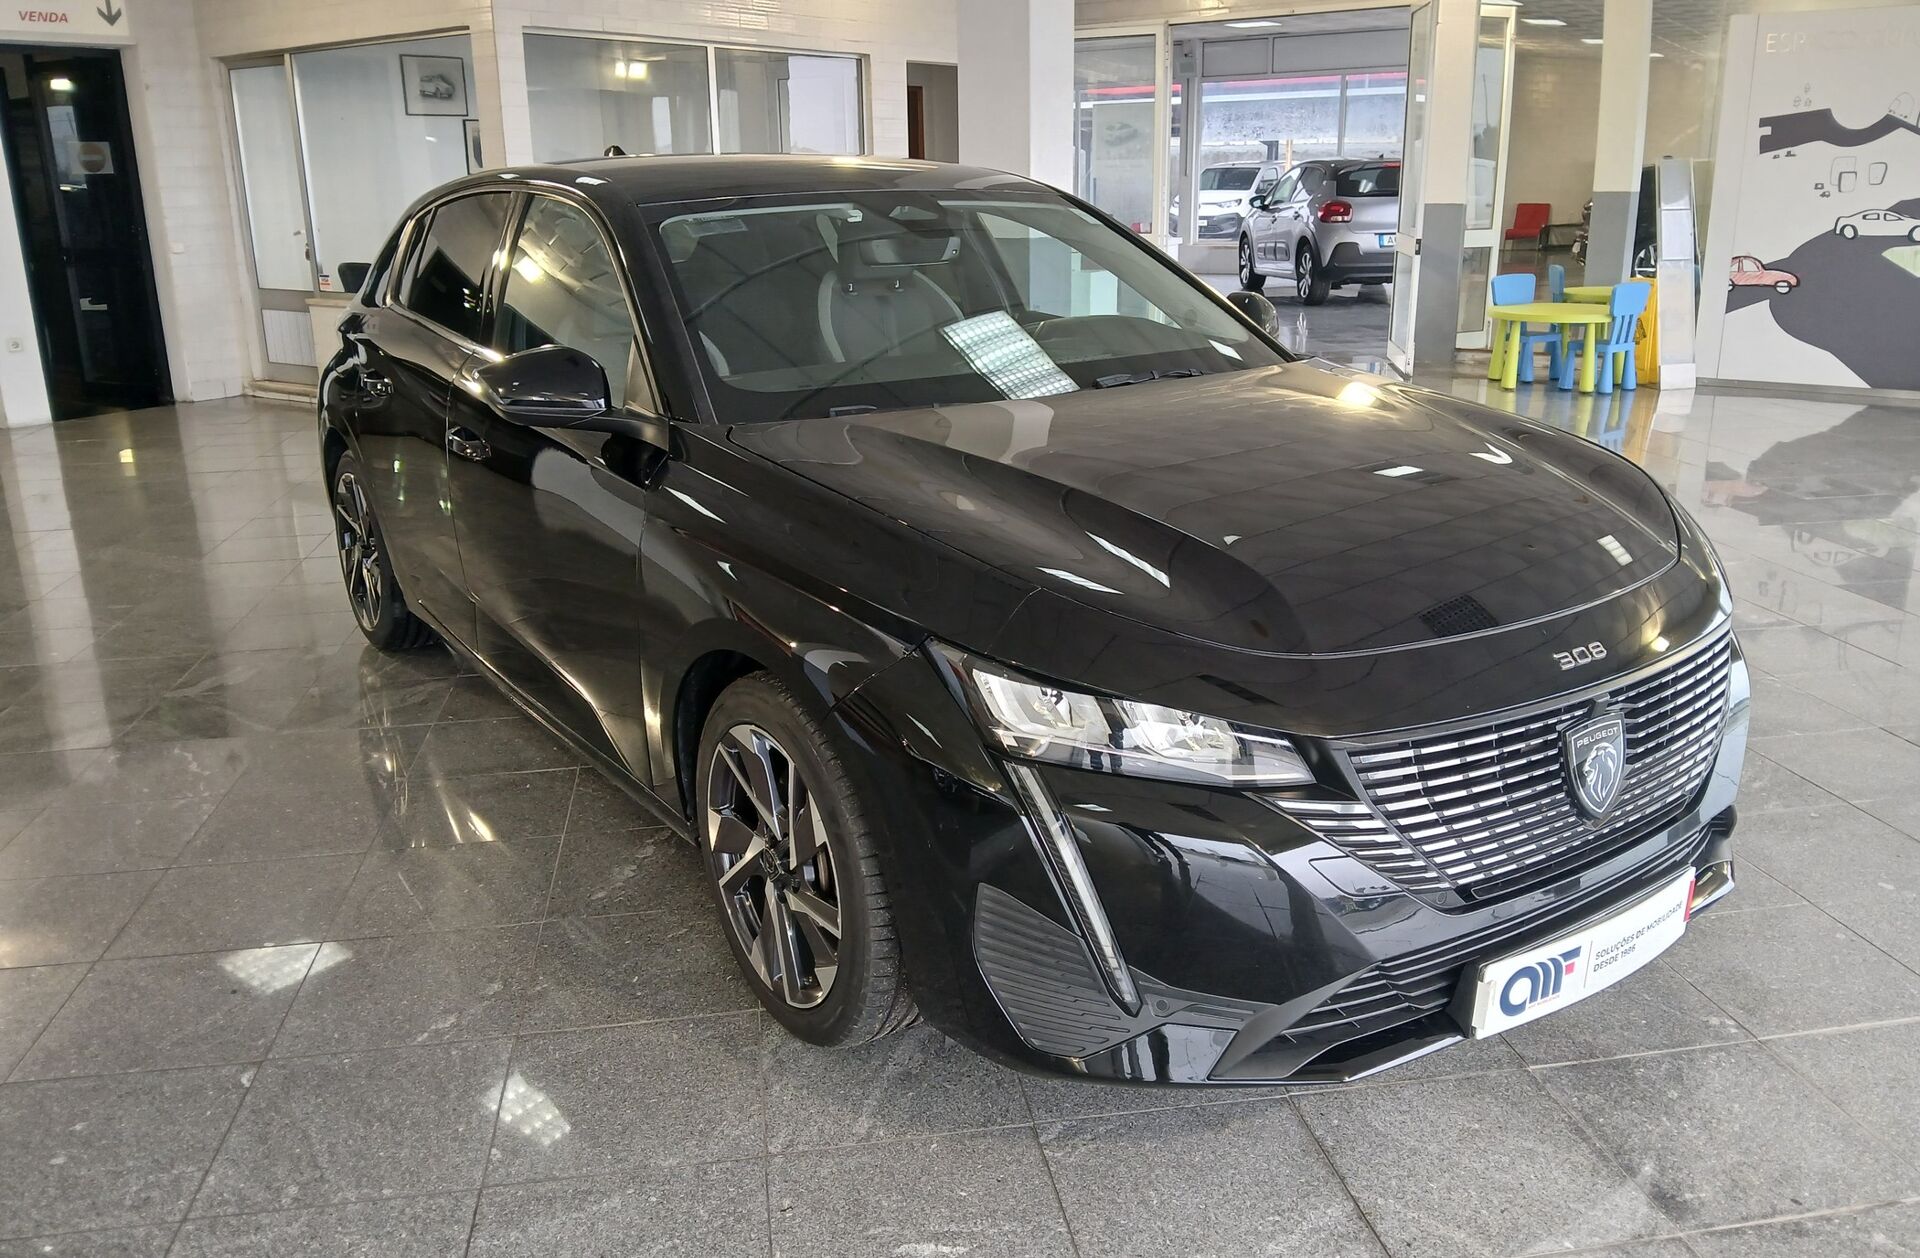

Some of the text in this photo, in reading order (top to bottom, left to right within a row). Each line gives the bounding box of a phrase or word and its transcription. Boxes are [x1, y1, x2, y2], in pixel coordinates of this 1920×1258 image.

[18, 10, 69, 23] VENDA
[1553, 641, 1607, 671] 308
[1577, 726, 1619, 748] PEUGEOT
[1595, 900, 1683, 961] SOLUÇÕES DE MOBILIDADE
[1593, 952, 1620, 973] DESDE
